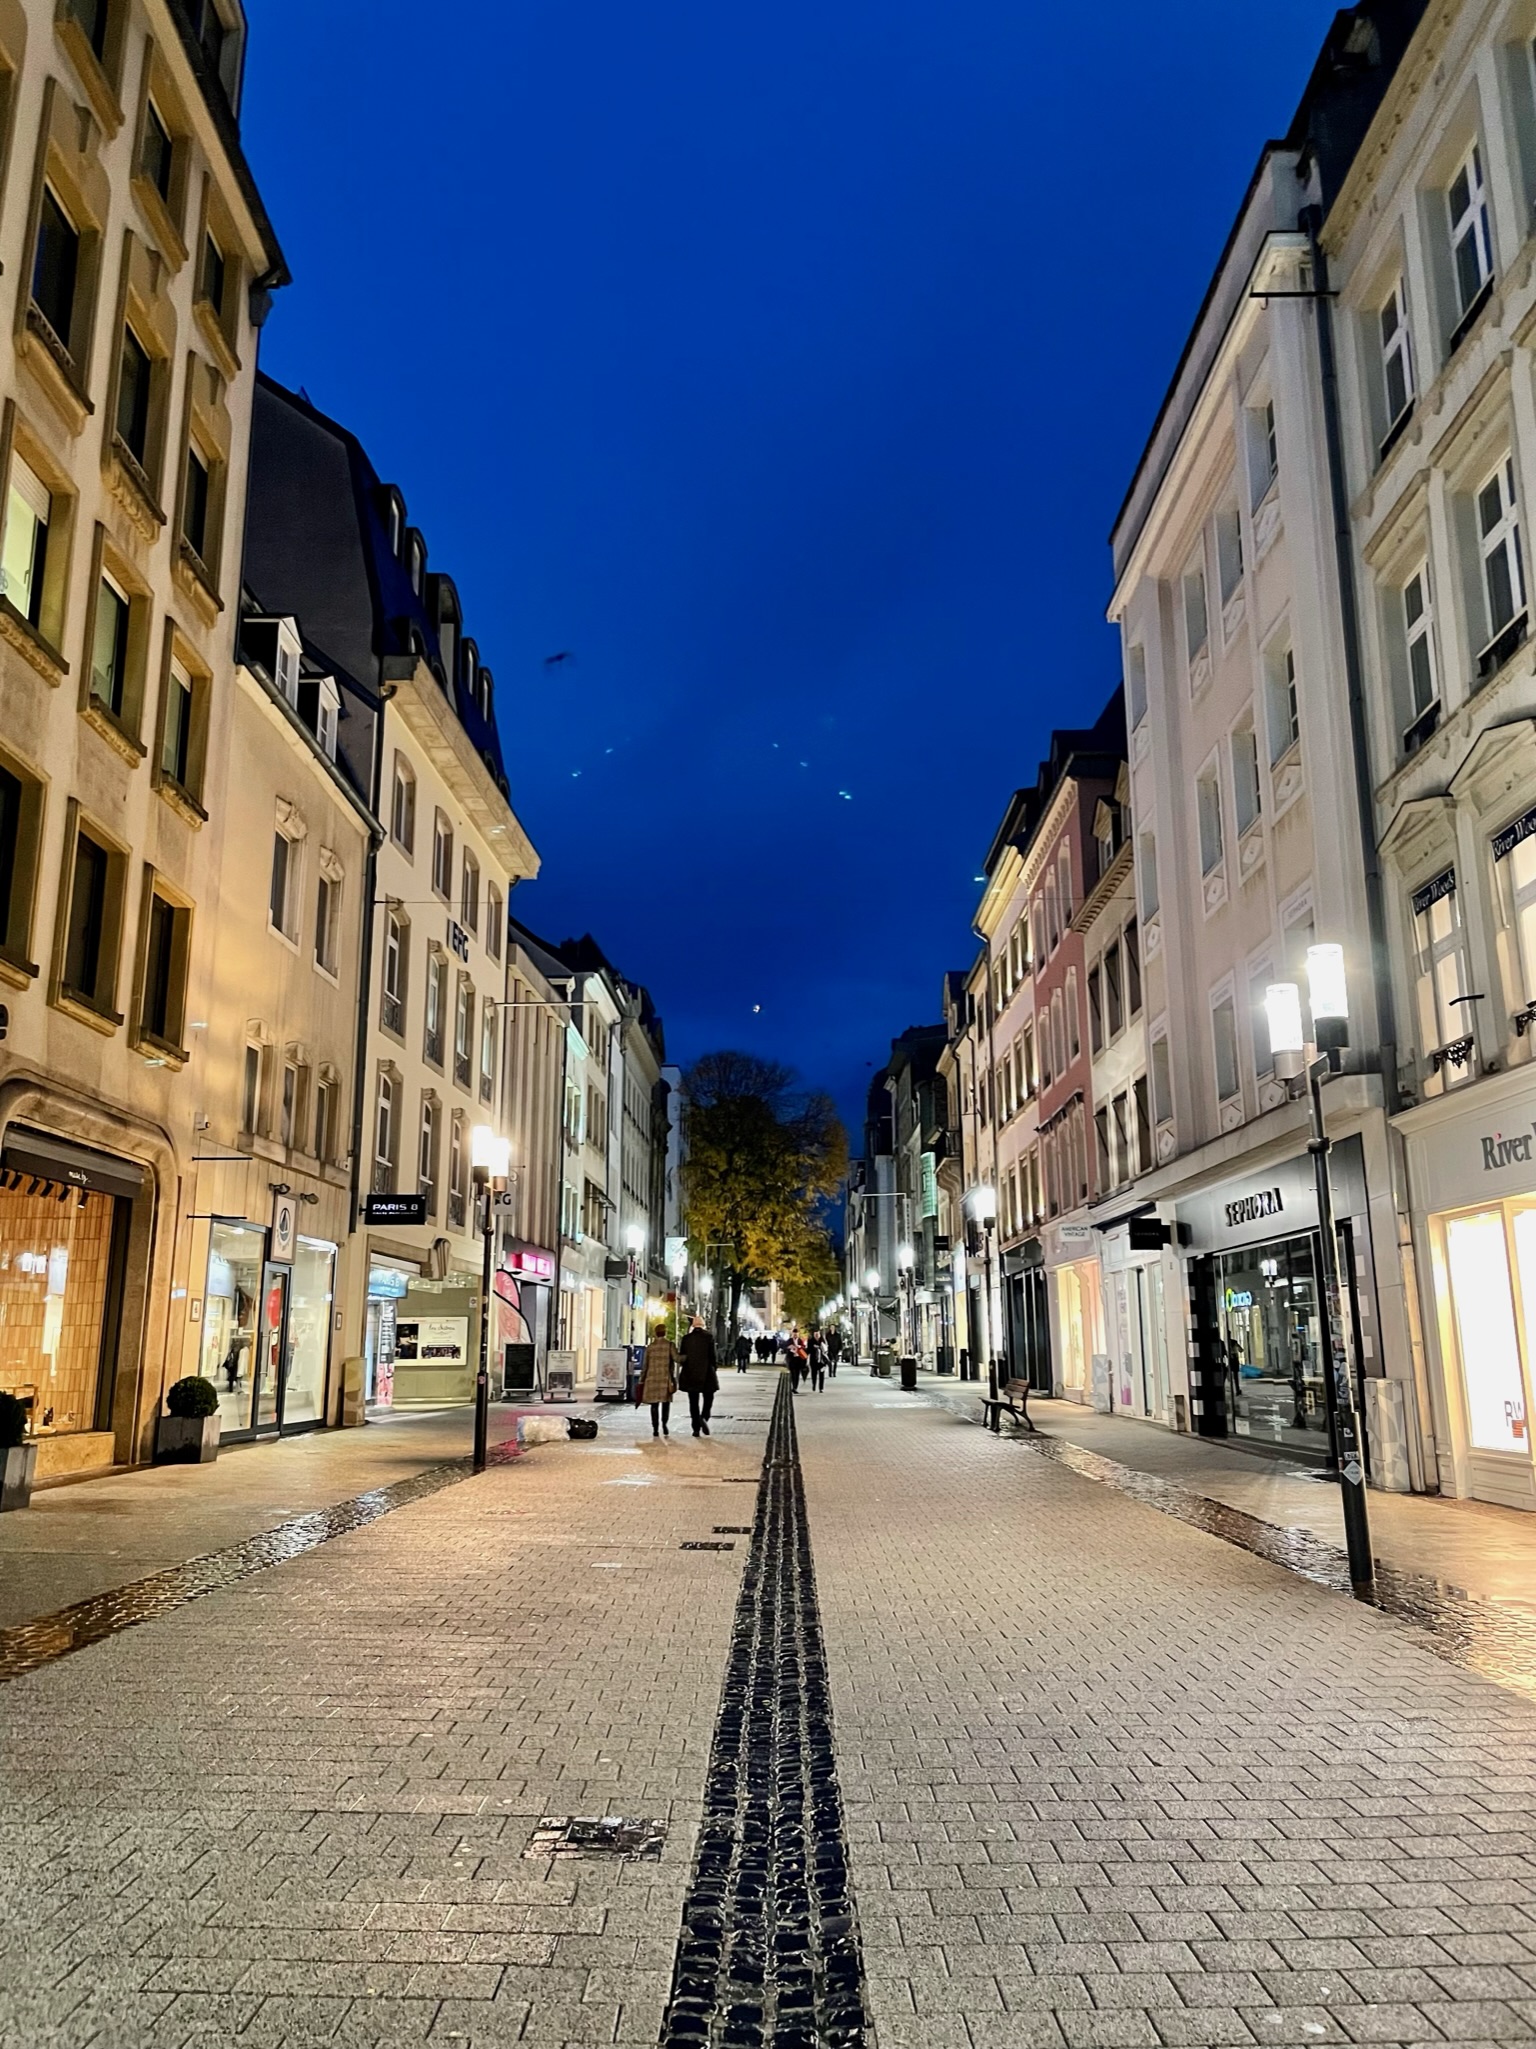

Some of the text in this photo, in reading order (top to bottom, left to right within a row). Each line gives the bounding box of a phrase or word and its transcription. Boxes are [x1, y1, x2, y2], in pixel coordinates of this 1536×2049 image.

[1430, 871, 1455, 901] Woods
[1480, 1132, 1533, 1172] River
[372, 1203, 419, 1211] PARIS 8
[1224, 1187, 1285, 1228] SEPHORA
